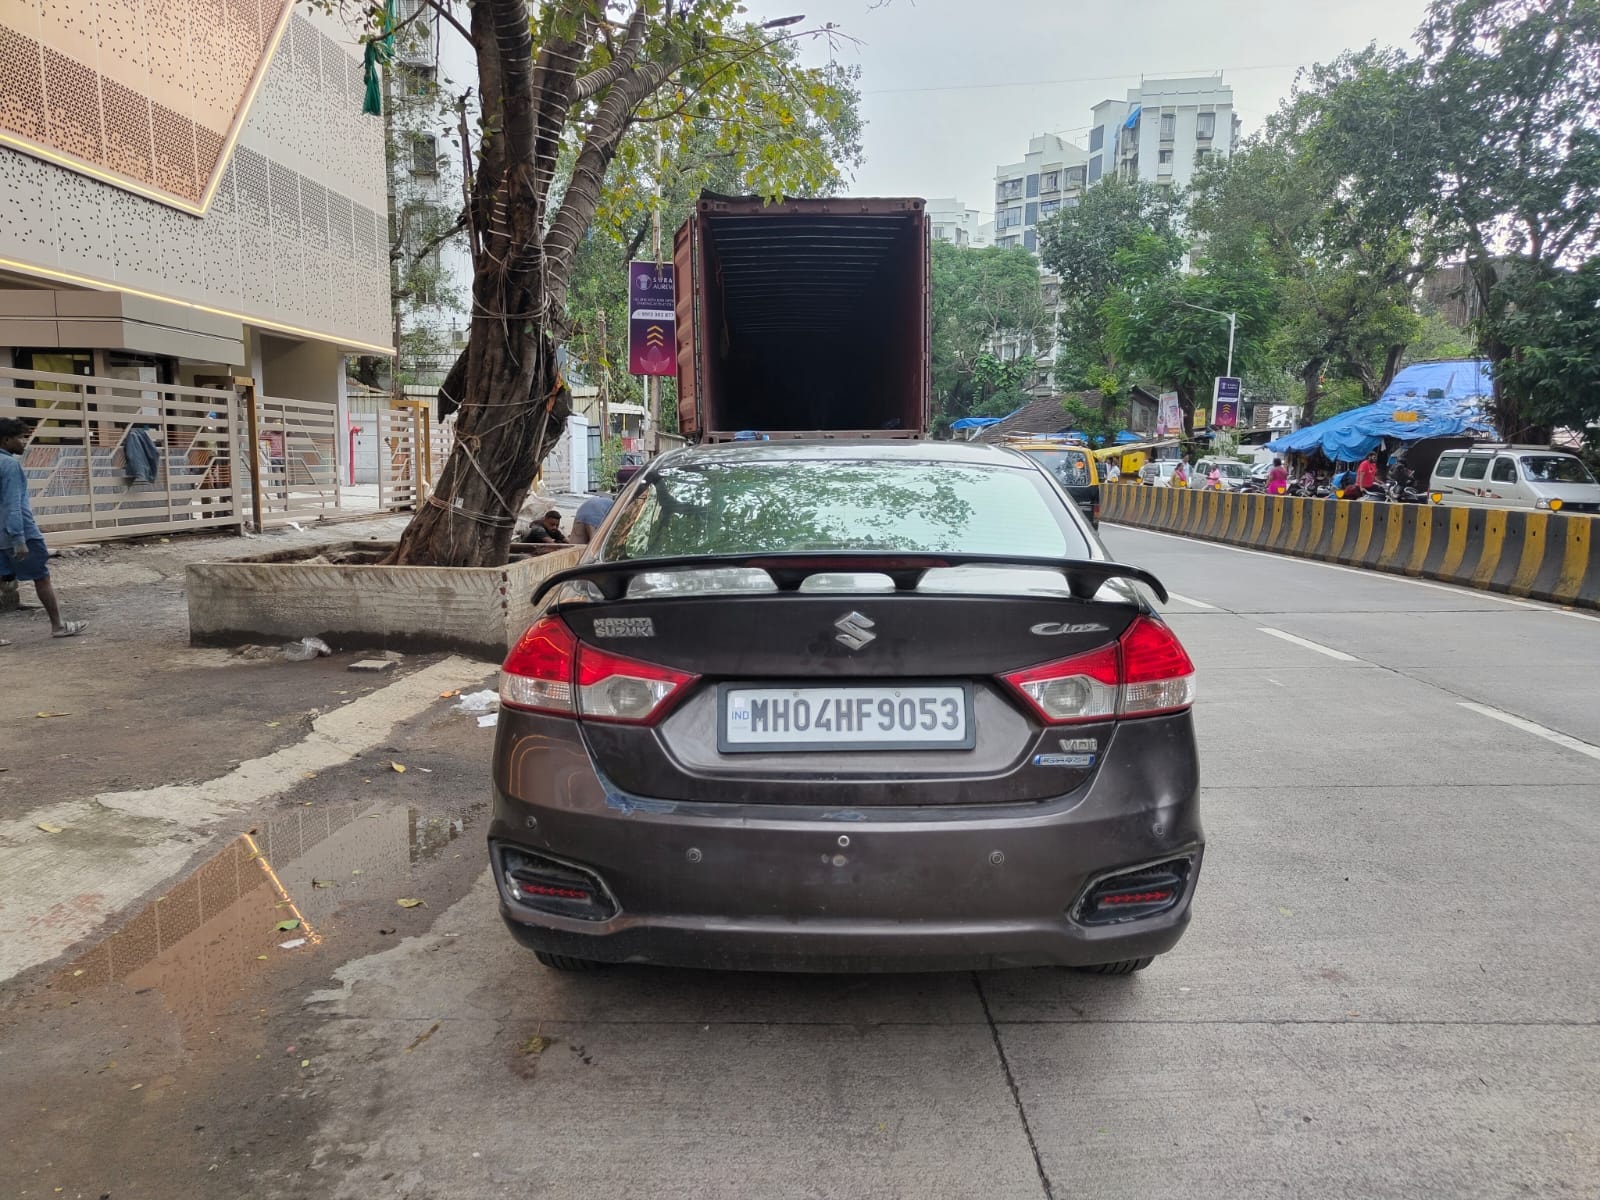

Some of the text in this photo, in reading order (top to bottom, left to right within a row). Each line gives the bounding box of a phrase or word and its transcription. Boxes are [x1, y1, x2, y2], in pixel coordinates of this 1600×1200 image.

[595, 627, 655, 637] SUZUKI
[731, 697, 960, 732] IND MH04HF9053
